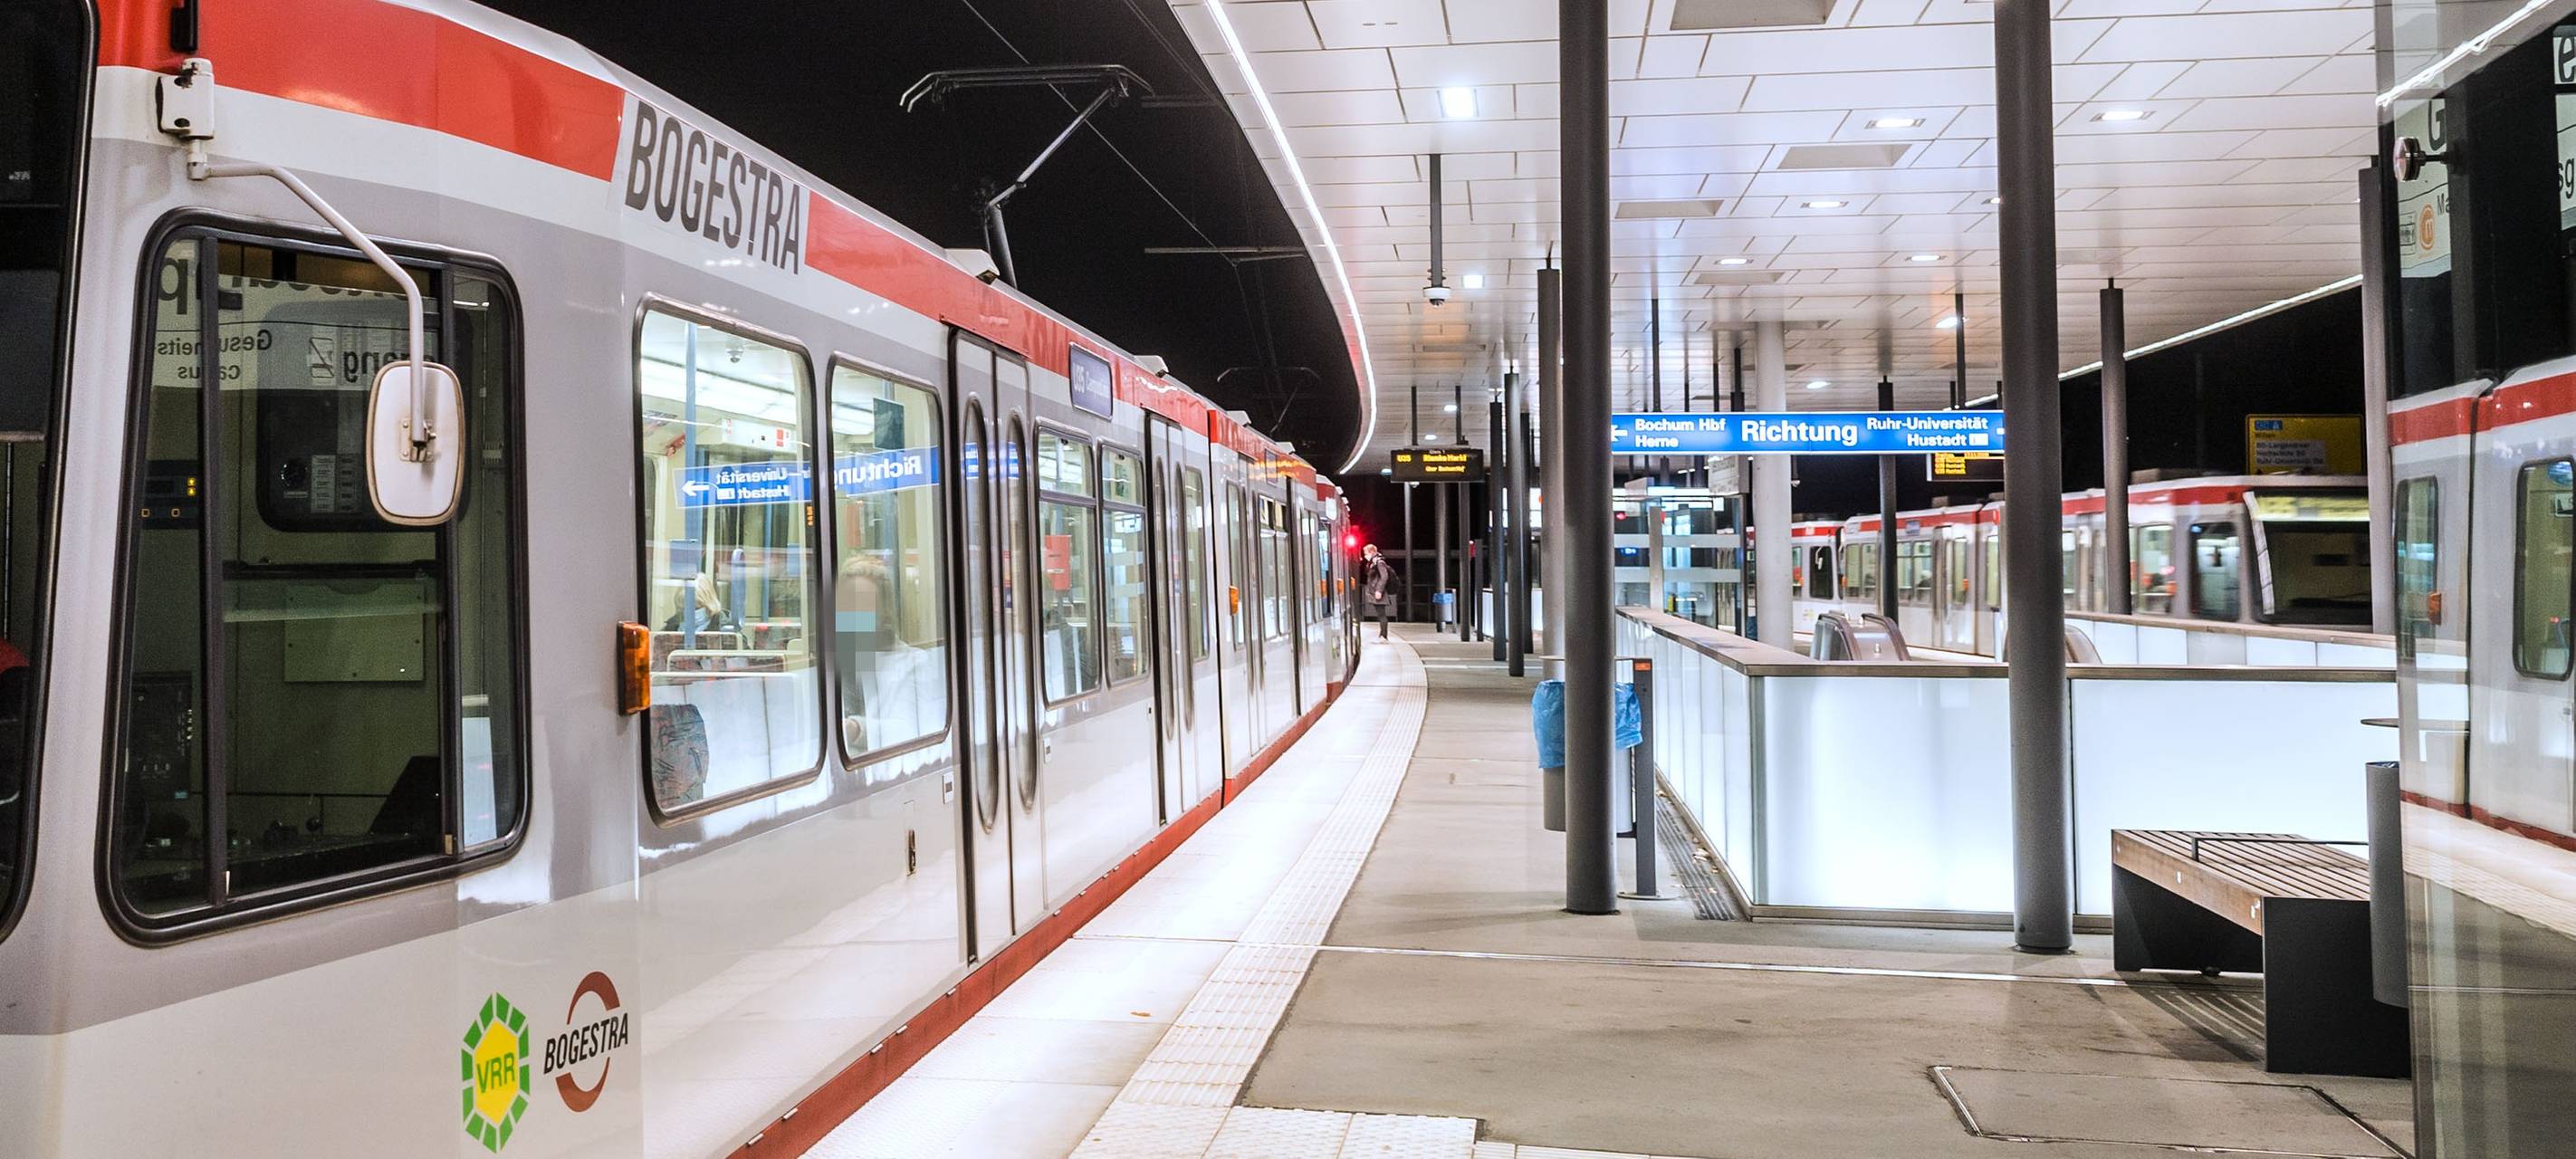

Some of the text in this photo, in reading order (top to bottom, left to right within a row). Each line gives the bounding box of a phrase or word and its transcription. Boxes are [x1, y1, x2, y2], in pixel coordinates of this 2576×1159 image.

[625, 101, 800, 274] BOGESTRA
[1634, 417, 1726, 432] Bochum Hbf
[1740, 419, 1858, 446] Richtung
[1866, 417, 1988, 430] Ruhr-Universität
[1634, 435, 1679, 448] Herne
[1906, 434, 1968, 446] Hustadt
[543, 1011, 628, 1076] BOGESTRA
[476, 1051, 515, 1094] VRR
